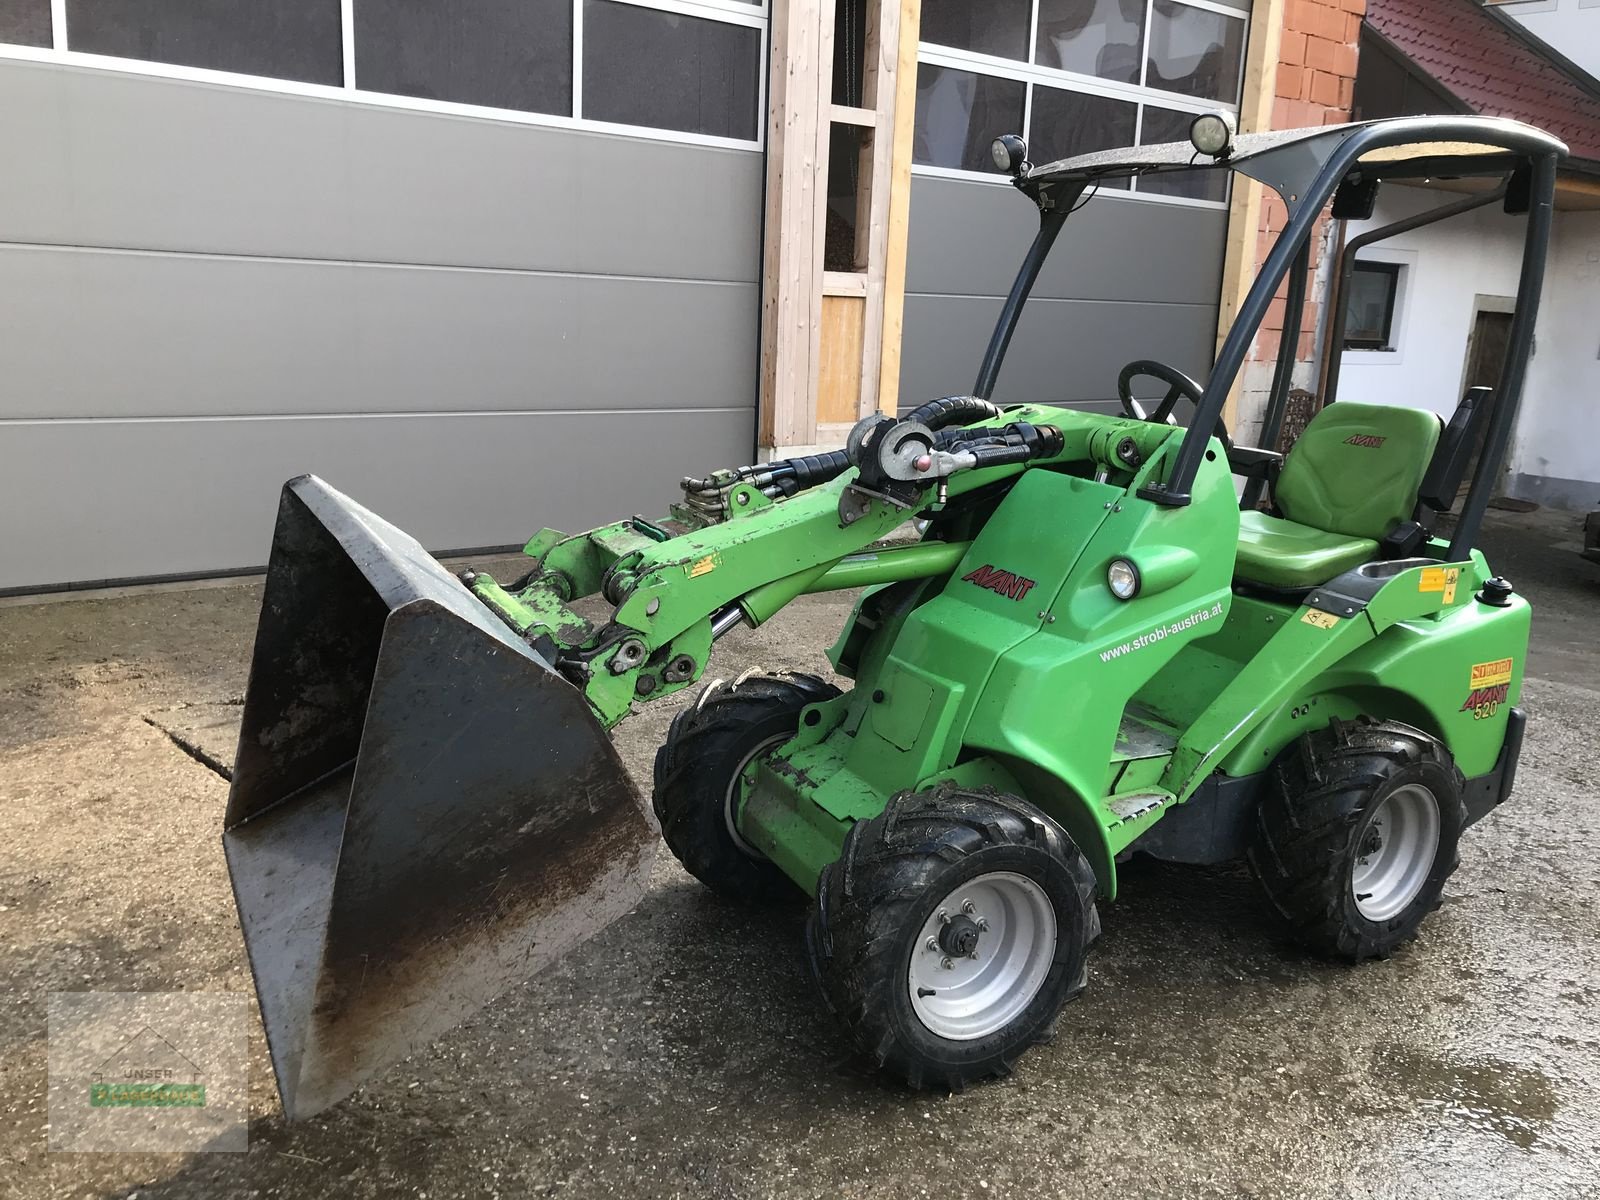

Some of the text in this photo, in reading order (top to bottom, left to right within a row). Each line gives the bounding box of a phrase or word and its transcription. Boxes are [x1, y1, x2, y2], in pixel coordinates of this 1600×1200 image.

[1342, 434, 1387, 448] AVANT
[961, 564, 1035, 601] AVANT
[1099, 601, 1224, 663] www.strobl-austria.at
[1459, 683, 1510, 712] AVANT
[1473, 699, 1498, 720] 520
